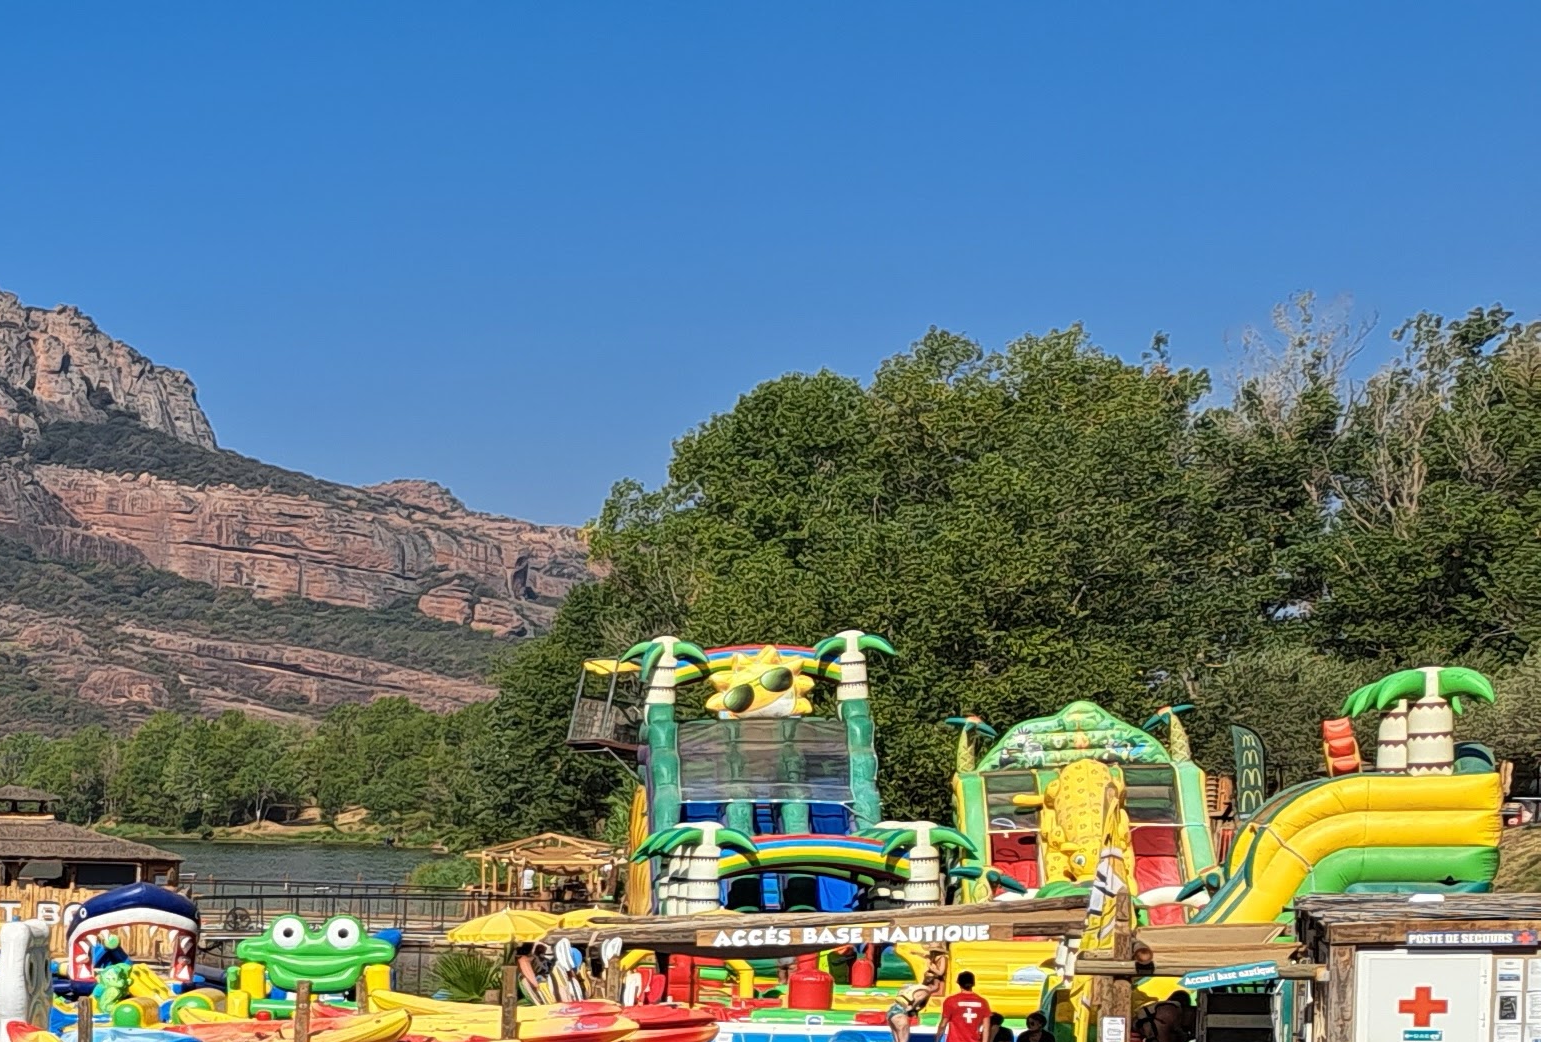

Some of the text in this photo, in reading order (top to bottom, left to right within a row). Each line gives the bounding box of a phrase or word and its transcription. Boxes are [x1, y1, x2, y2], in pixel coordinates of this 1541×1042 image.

[803, 927, 863, 944] BASE
[873, 924, 990, 943] NAUTIQUE
[1408, 933, 1514, 944] POSTE DE SECOURS
[1184, 973, 1215, 986] Accueil
[1217, 971, 1238, 981] base
